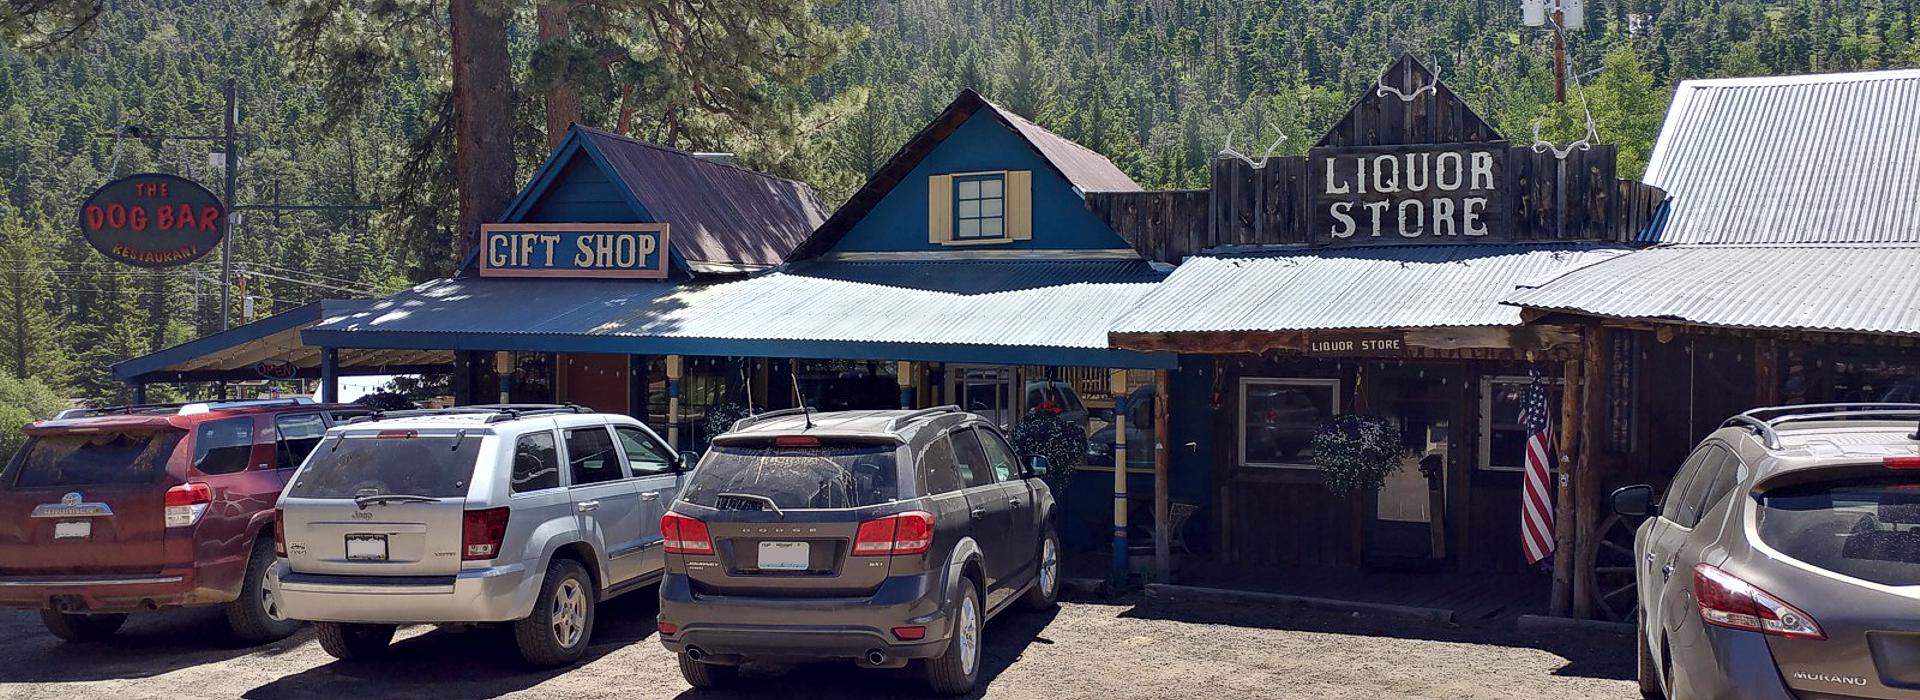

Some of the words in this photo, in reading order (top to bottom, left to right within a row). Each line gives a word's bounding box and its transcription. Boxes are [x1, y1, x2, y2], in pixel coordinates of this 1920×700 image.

[1325, 152, 1495, 194] LIQUOR
[136, 183, 169, 197] THE
[86, 202, 148, 231] DOG
[157, 203, 220, 232] BAR
[1330, 197, 1489, 238] STORE
[112, 243, 198, 263] RESTAURANT
[490, 233, 561, 268] GIFT
[574, 234, 657, 268] SHOP
[1312, 341, 1354, 352] LIQUOR
[1361, 340, 1400, 351] STORE
[256, 361, 291, 377] OPEN
[1793, 671, 1867, 686] MURANO
